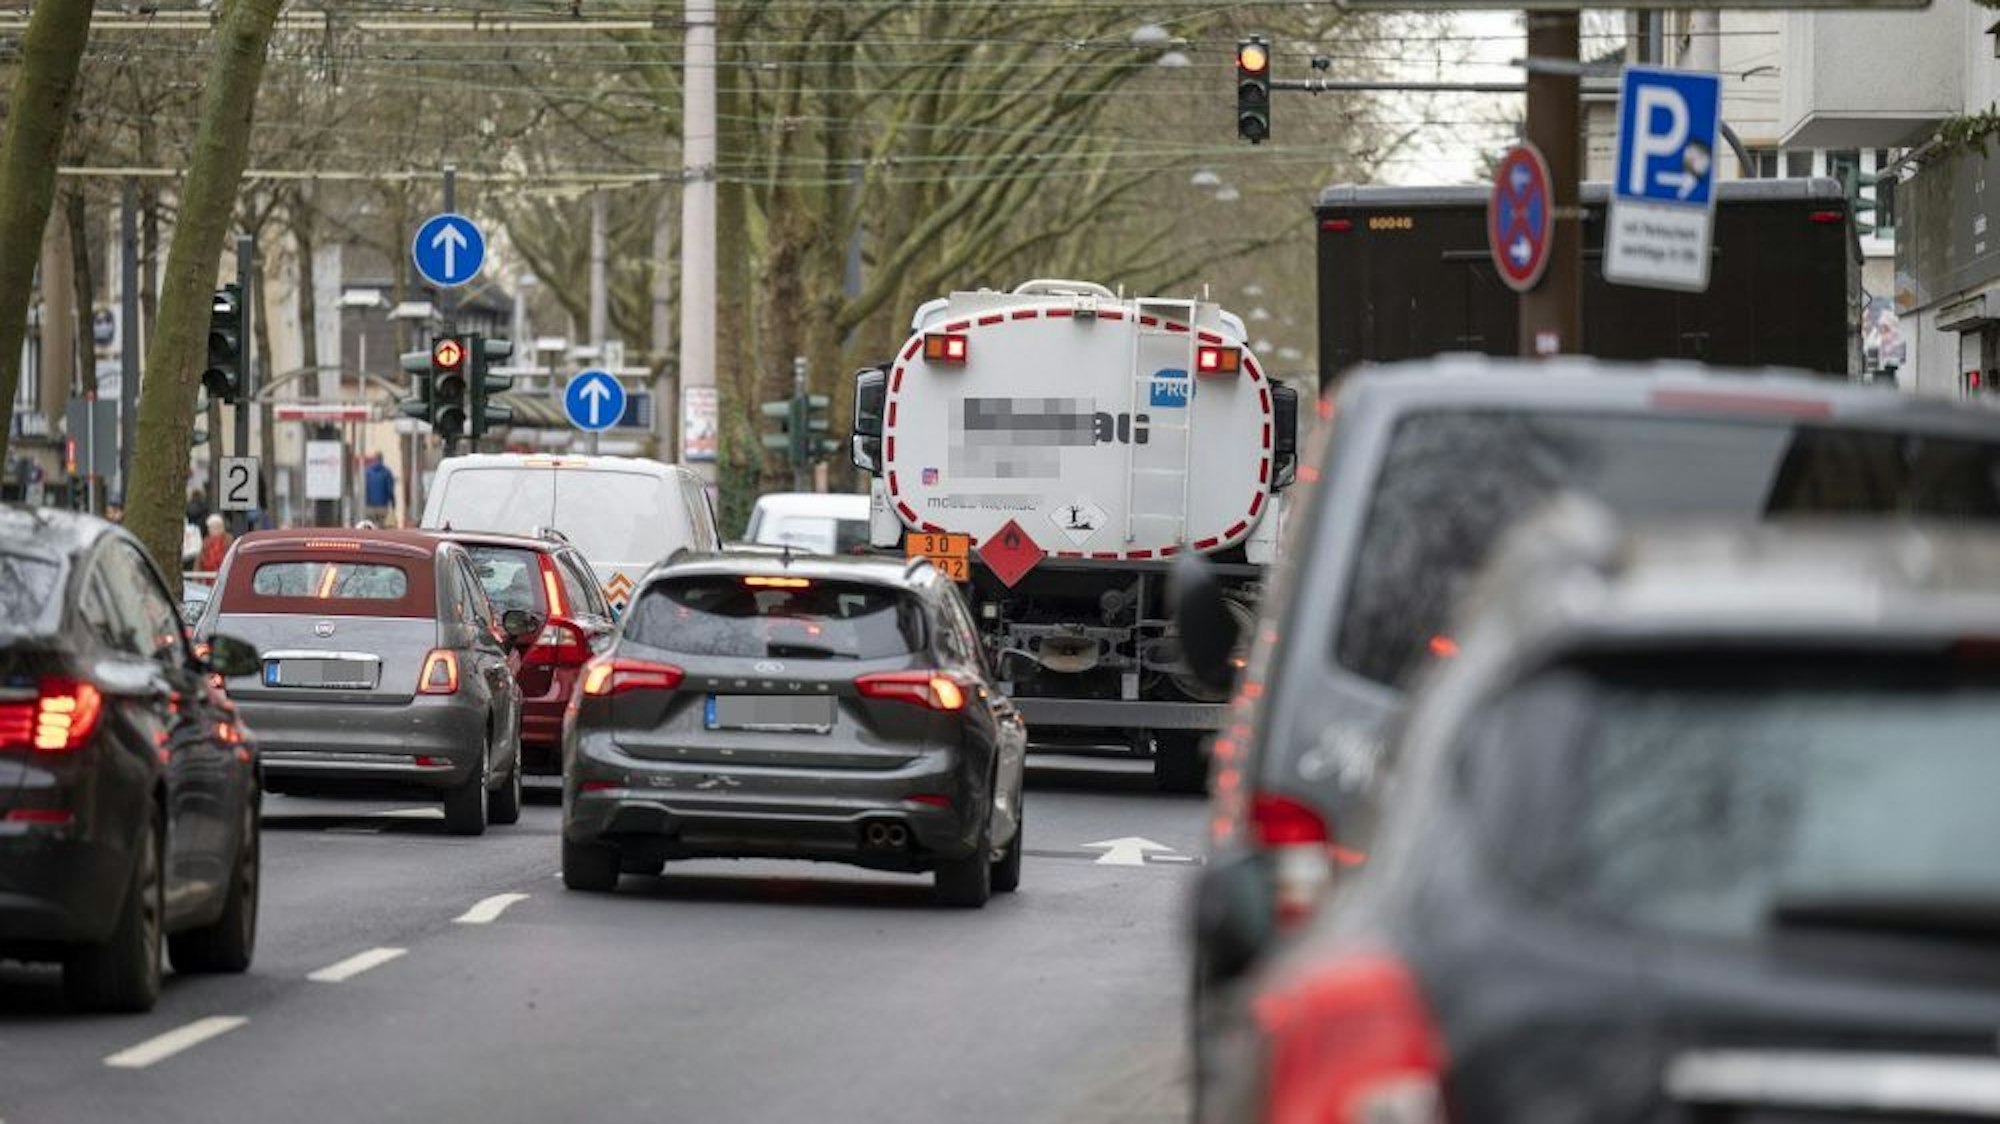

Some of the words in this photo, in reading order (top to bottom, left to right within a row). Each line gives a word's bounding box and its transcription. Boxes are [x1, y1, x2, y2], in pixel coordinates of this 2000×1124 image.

[1629, 83, 1690, 196] P
[228, 465, 248, 502] 2
[925, 536, 948, 552] 30
